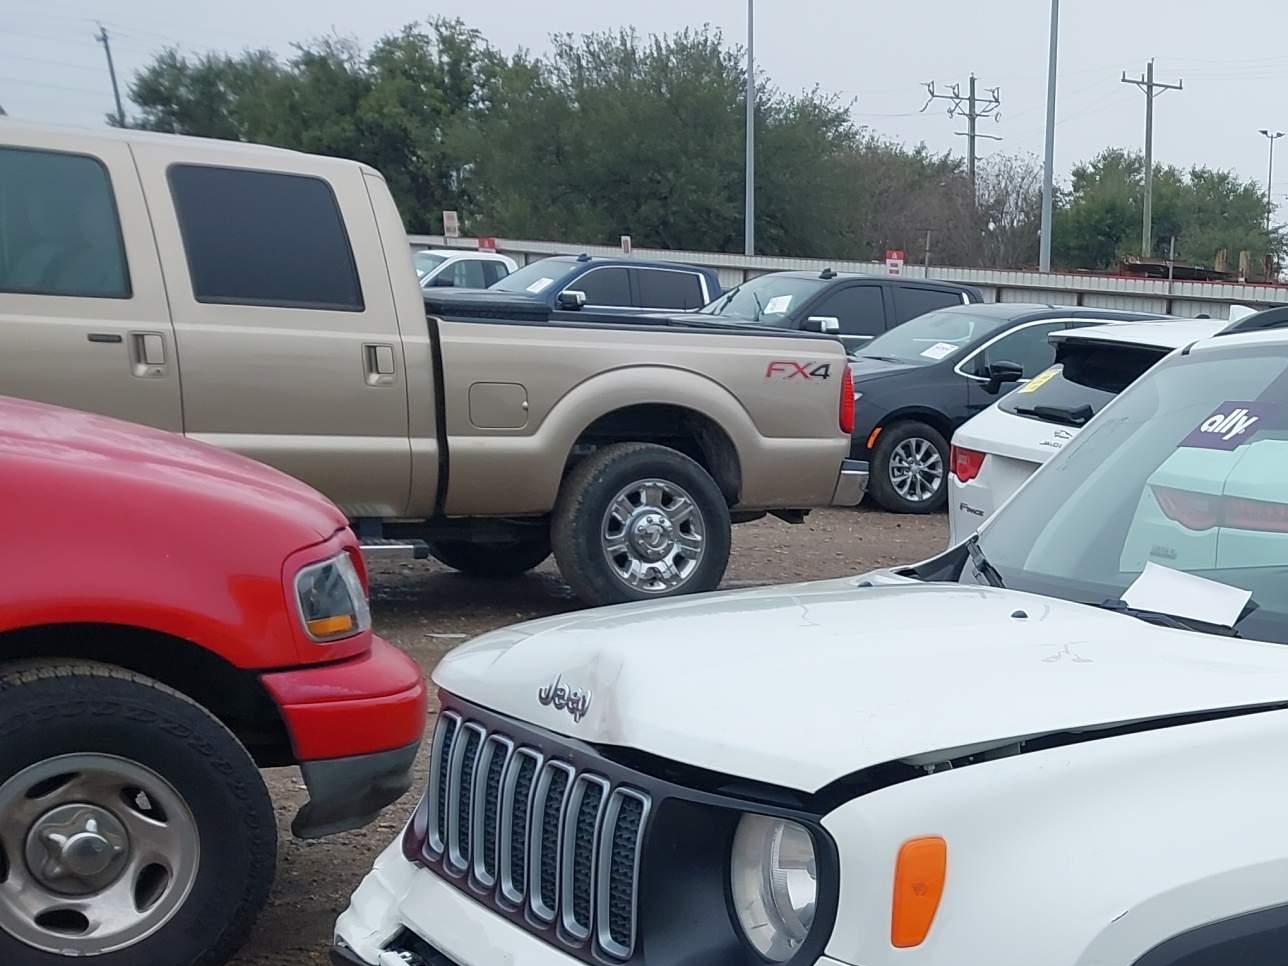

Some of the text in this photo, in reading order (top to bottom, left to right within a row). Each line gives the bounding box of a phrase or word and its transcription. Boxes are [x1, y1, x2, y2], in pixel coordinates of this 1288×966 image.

[765, 361, 831, 380] FX4
[1200, 408, 1259, 440] ally
[538, 673, 592, 723] Jeep
